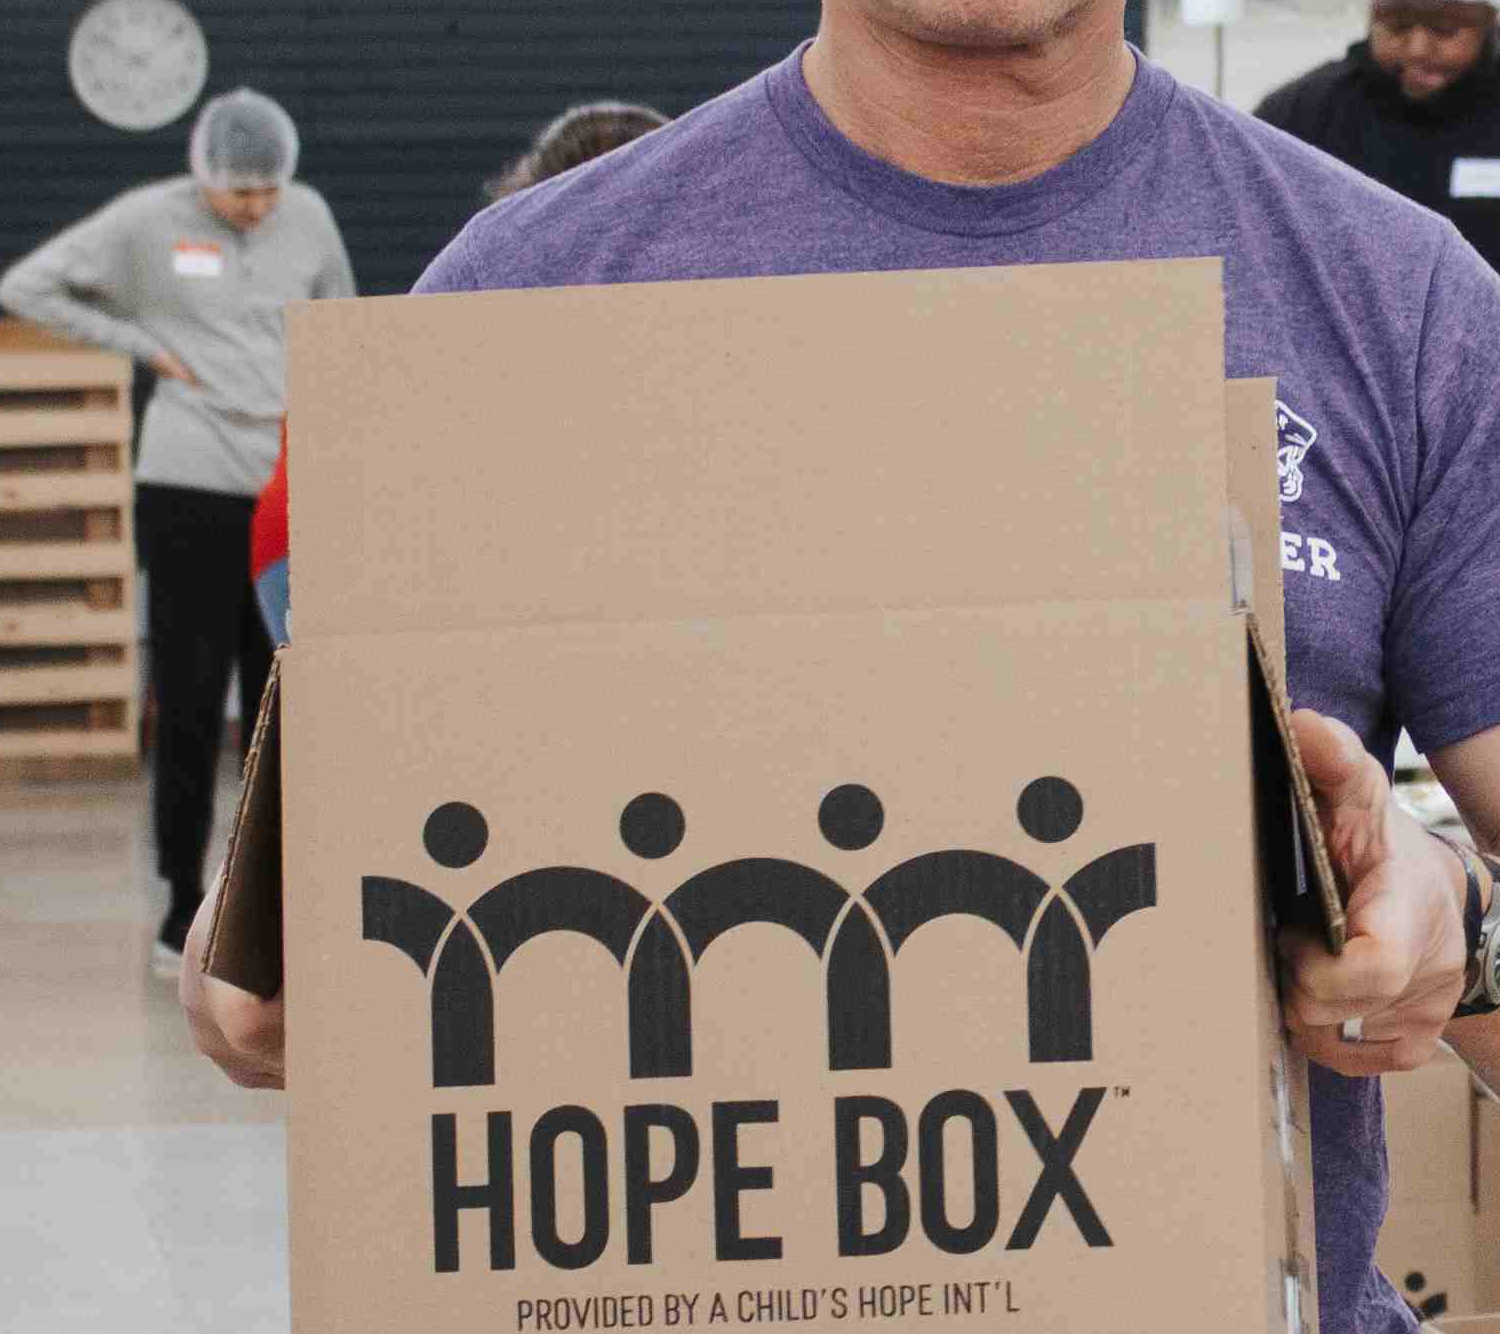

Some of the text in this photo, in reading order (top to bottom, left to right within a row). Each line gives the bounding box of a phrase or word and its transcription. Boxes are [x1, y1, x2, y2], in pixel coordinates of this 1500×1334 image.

[432, 1099, 783, 1274] HOPE
[835, 1086, 1113, 1258] BOX
[516, 1278, 1020, 1332] PROVIDED BY A CHILD'S HOPE INT'L
